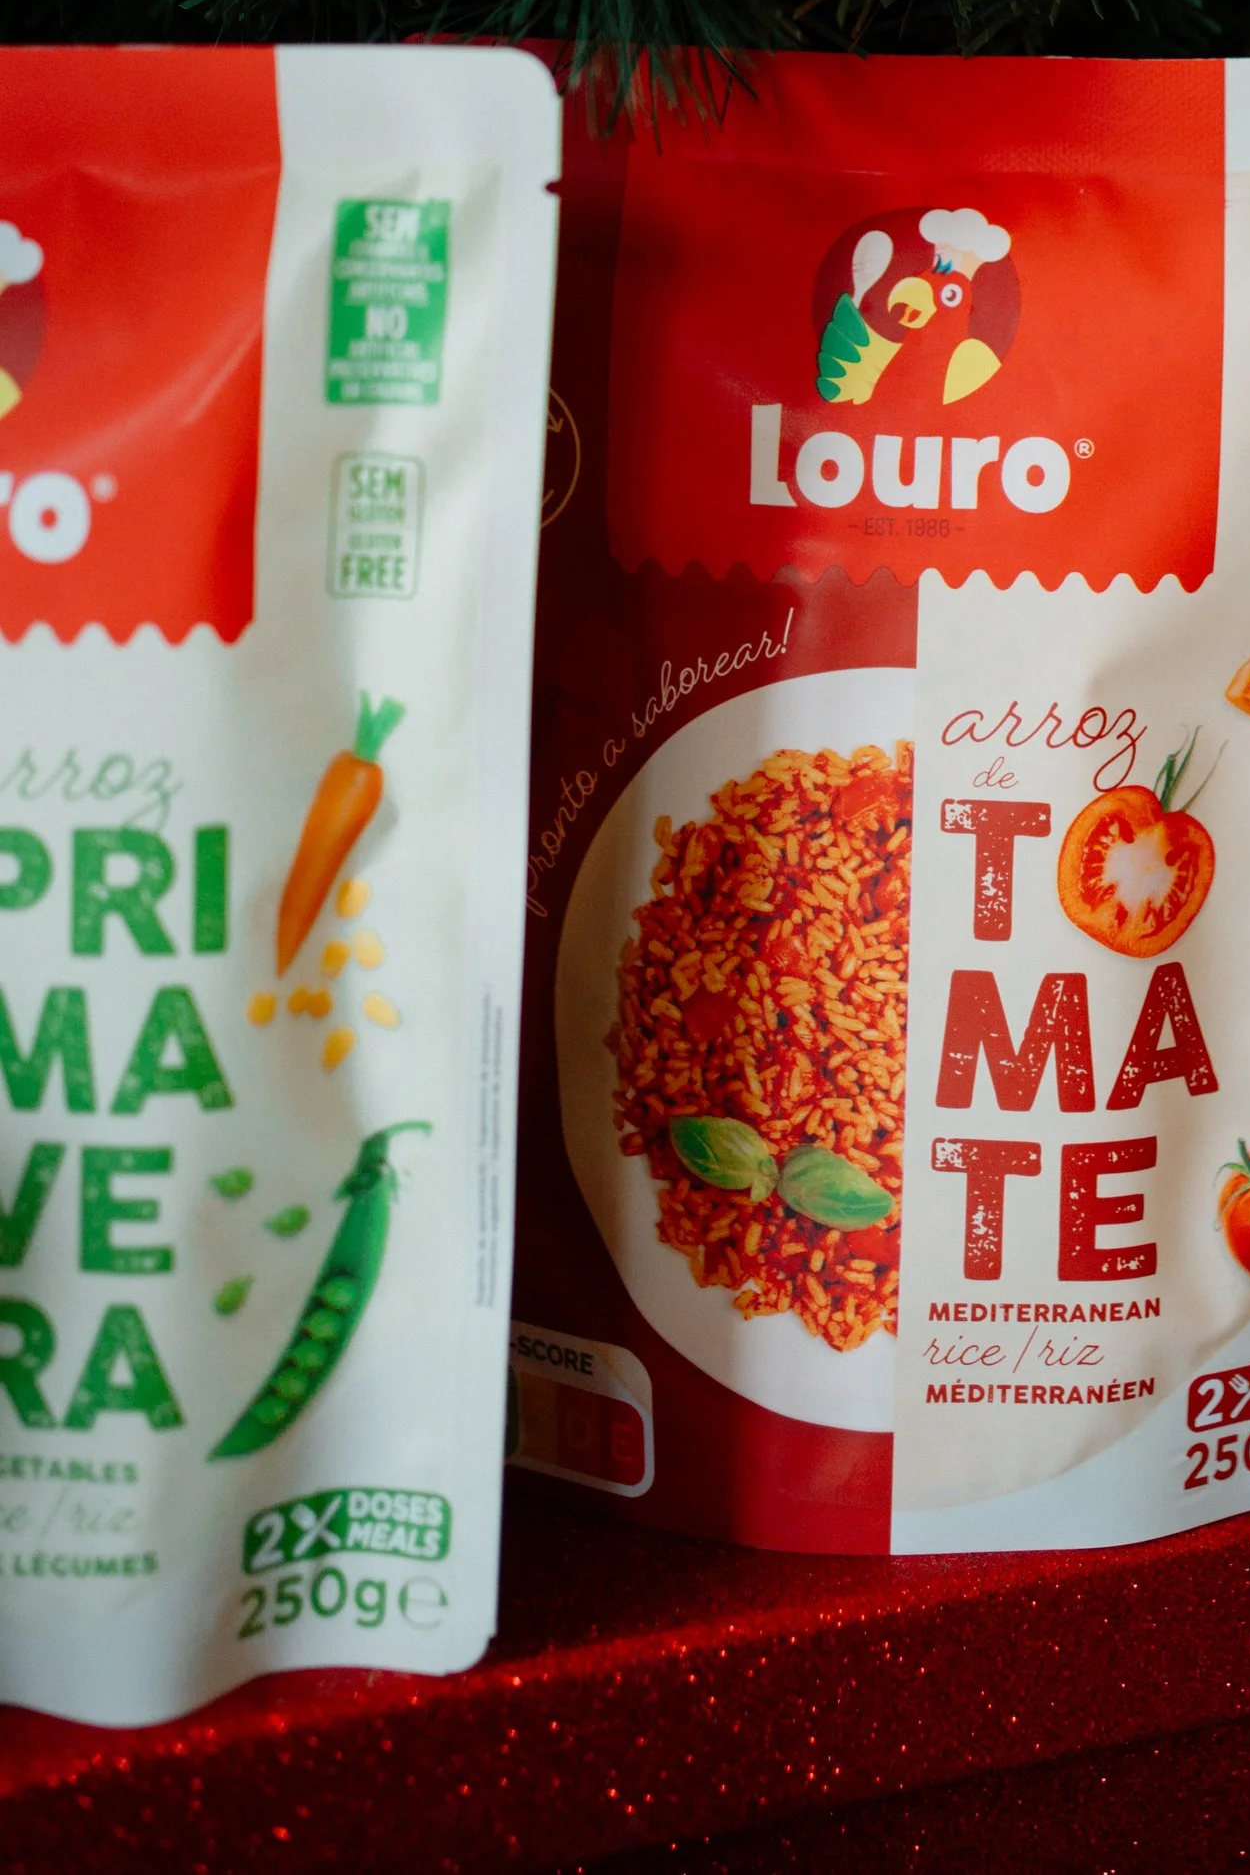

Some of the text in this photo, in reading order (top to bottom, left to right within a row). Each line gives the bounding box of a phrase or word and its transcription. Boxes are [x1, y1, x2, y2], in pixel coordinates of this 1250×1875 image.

[351, 464, 405, 500] SEM
[340, 553, 407, 588] FREE
[603, 738, 626, 767] a
[631, 607, 794, 738] saborear!
[941, 701, 1148, 793] arroz
[0, 747, 184, 831] rroz
[973, 756, 1020, 789] de
[935, 962, 1220, 1113] MA
[931, 1135, 1157, 1282] TE
[928, 1297, 1161, 1323] MEDITERRANEAN
[926, 1377, 1155, 1405] MÉDITERRANÉEN
[348, 1491, 443, 1526] DOSES
[346, 1522, 441, 1556] MEALS
[238, 1567, 387, 1641] 250g
